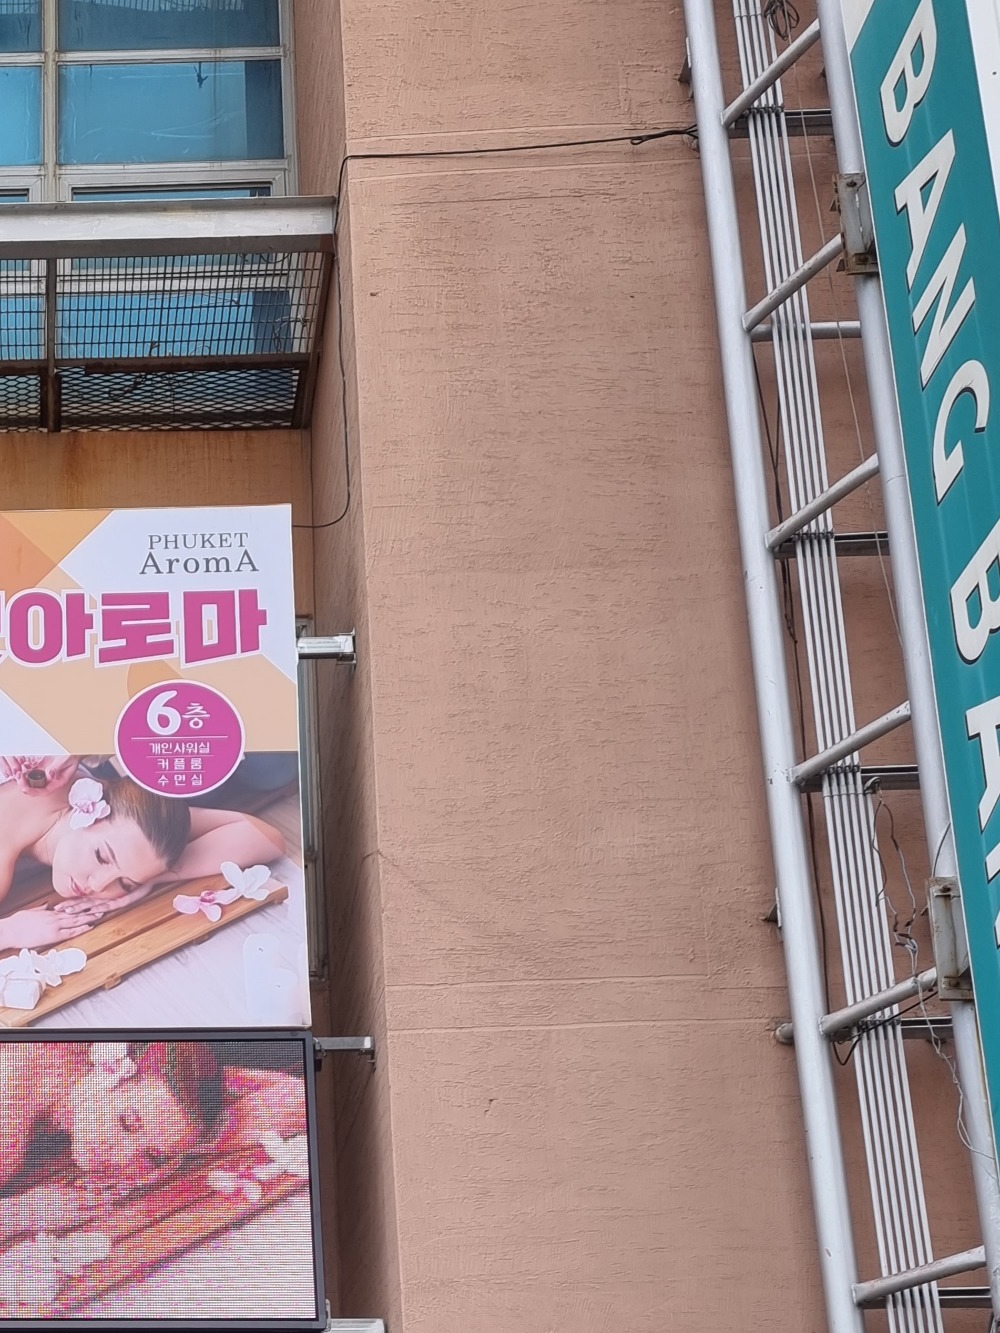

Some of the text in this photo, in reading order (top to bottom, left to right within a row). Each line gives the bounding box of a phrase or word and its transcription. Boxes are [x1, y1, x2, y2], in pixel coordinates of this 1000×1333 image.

[880, 0, 990, 507] BANG
[147, 532, 249, 551] PHUKET
[139, 551, 260, 575] AromA
[147, 690, 211, 735] 6층
